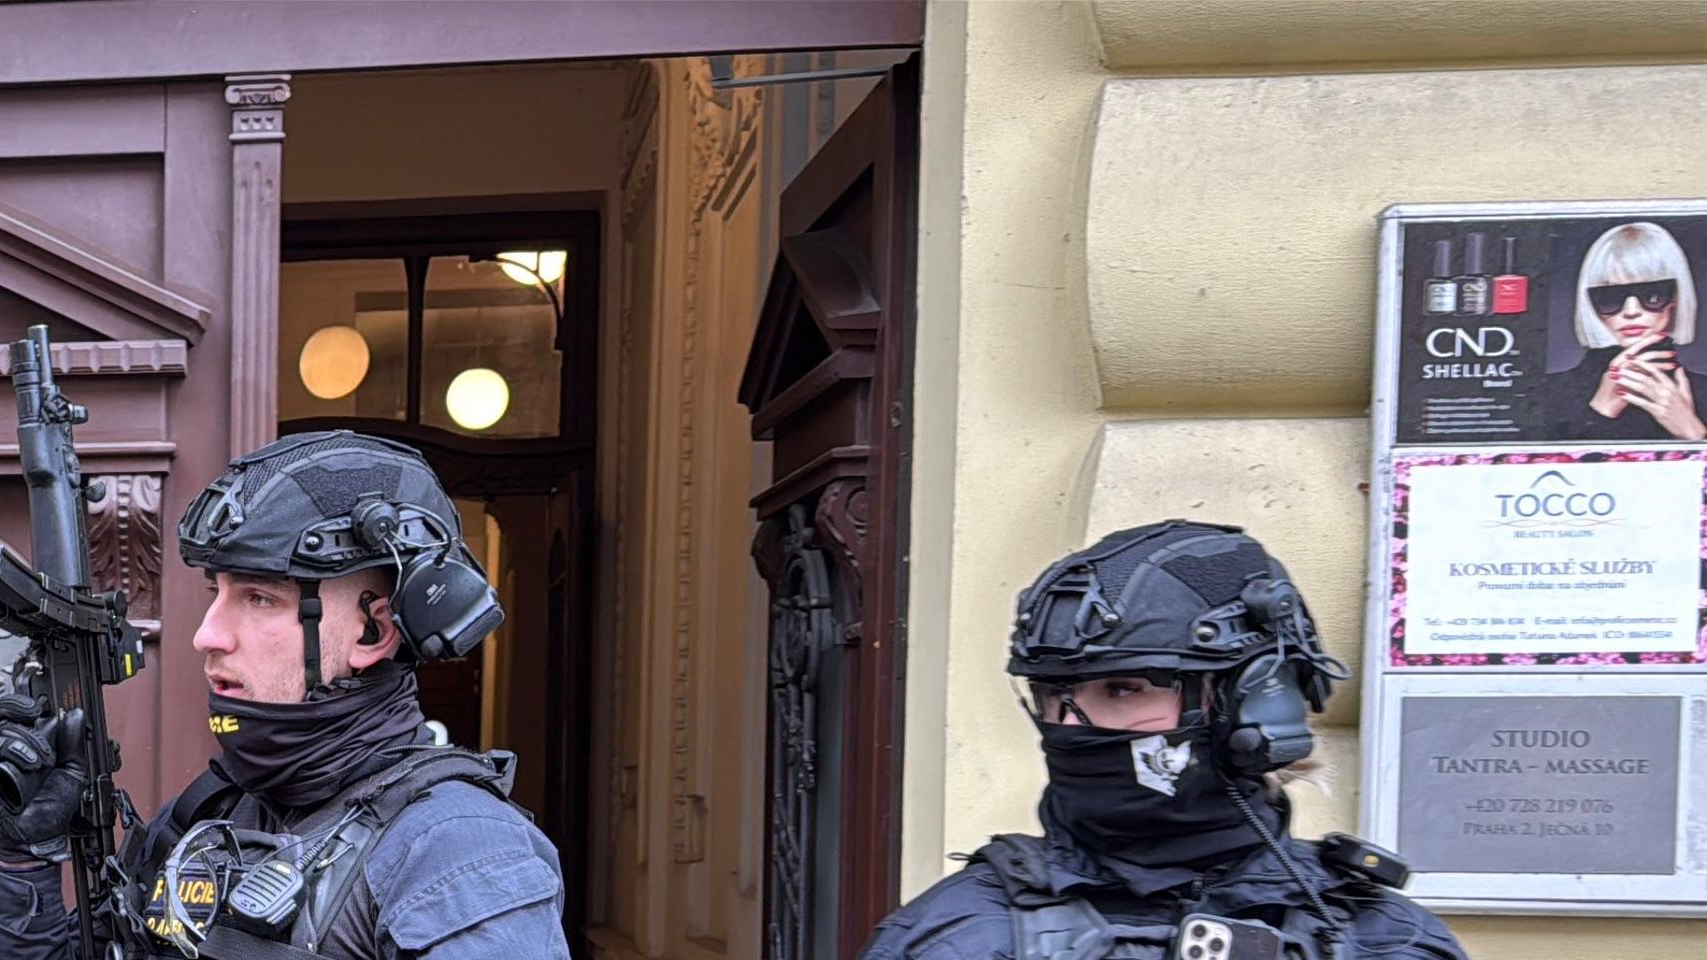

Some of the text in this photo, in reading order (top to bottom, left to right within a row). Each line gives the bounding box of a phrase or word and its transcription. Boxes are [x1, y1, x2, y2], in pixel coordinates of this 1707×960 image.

[1425, 327, 1515, 358] CND
[1422, 363, 1514, 379] SHELLAC
[1495, 492, 1617, 518] TOCCO
[1491, 729, 1591, 749] STUDIO
[1432, 756, 1523, 775] TANTRA
[1544, 758, 1650, 775] MASSAGE
[1545, 798, 1578, 813] 219
